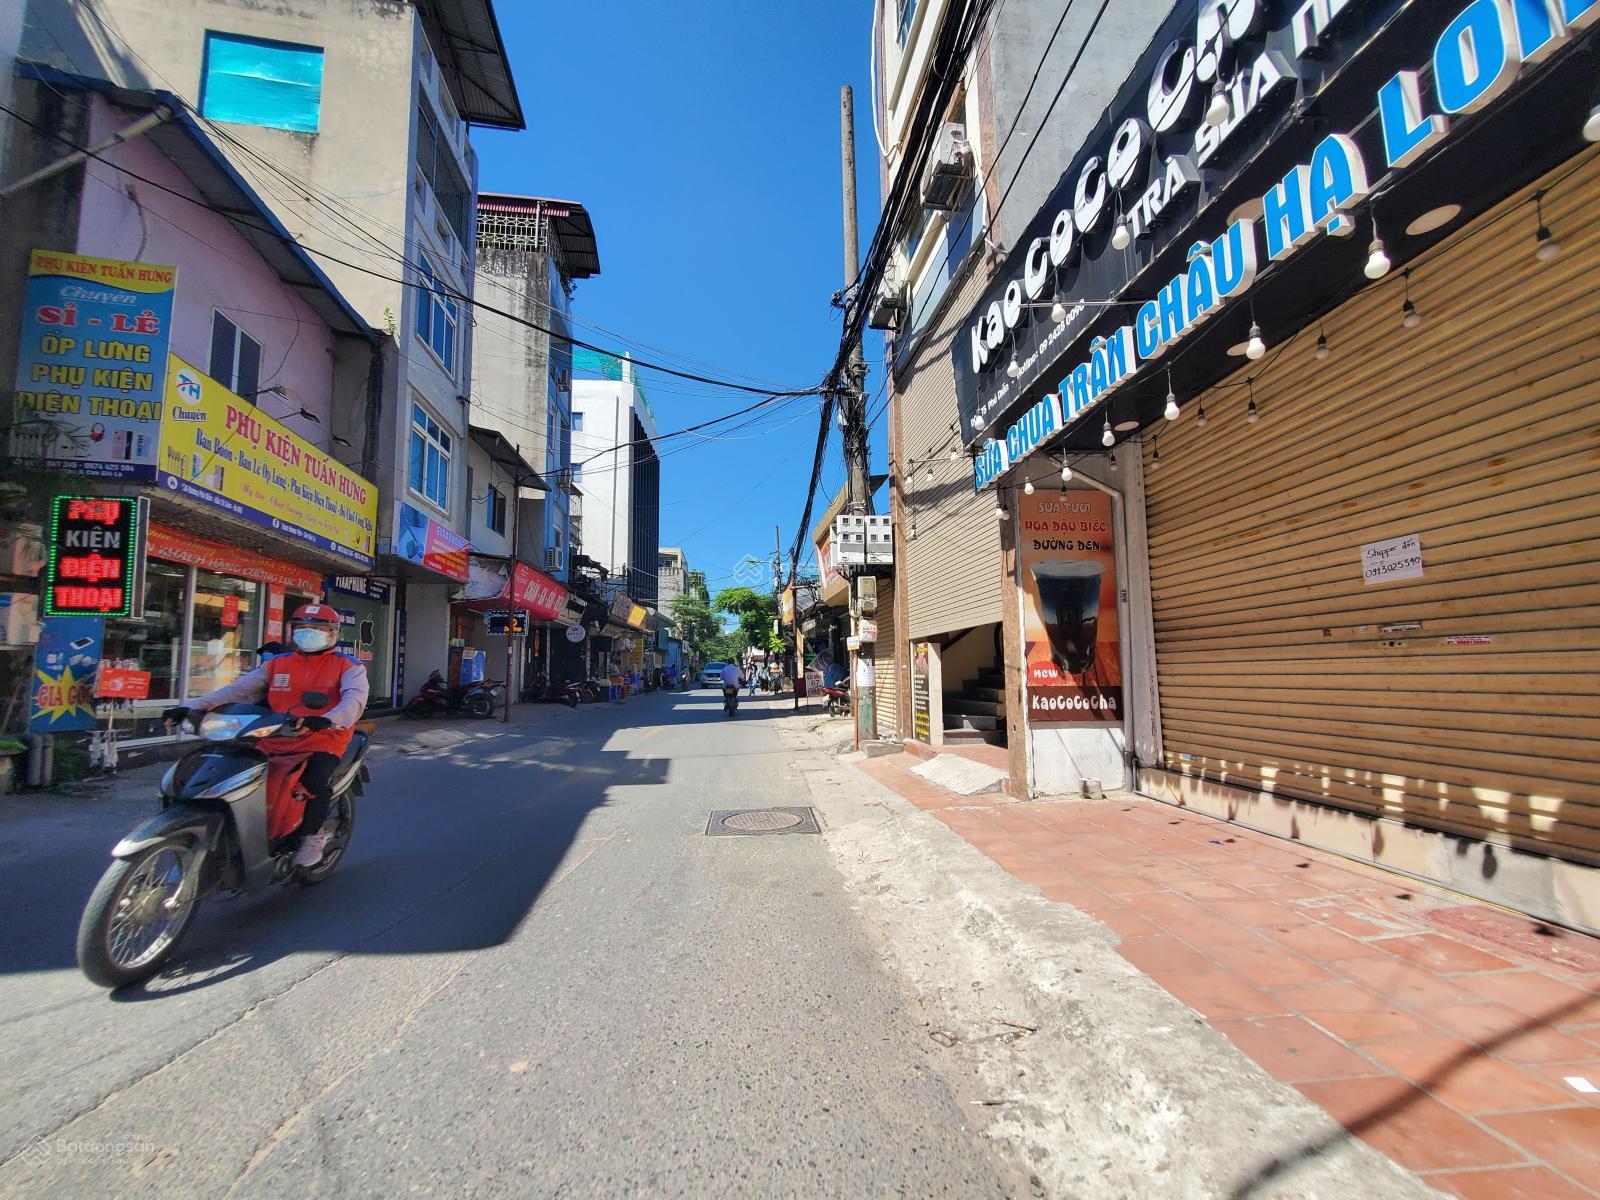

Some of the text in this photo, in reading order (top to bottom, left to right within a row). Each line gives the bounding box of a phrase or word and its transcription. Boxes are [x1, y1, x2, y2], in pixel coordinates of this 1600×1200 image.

[36, 255, 172, 284] PHỤ KIỆN TUẤN HƯNG
[59, 284, 137, 304] Chuyên
[1007, 394, 1056, 462] CHUA
[1059, 326, 1130, 422] TRÂN
[1136, 219, 1248, 360] CHÂU
[1263, 134, 1358, 261] HẠ
[83, 338, 151, 363] LƯNG
[31, 363, 153, 393] PHỤ KIỆN
[88, 396, 163, 424] THOẠI
[226, 405, 367, 505] PHỤ KIỆN TUẤN HƯNG
[1034, 668, 1058, 678] new
[1032, 694, 1116, 710] KaoCoCoCha
